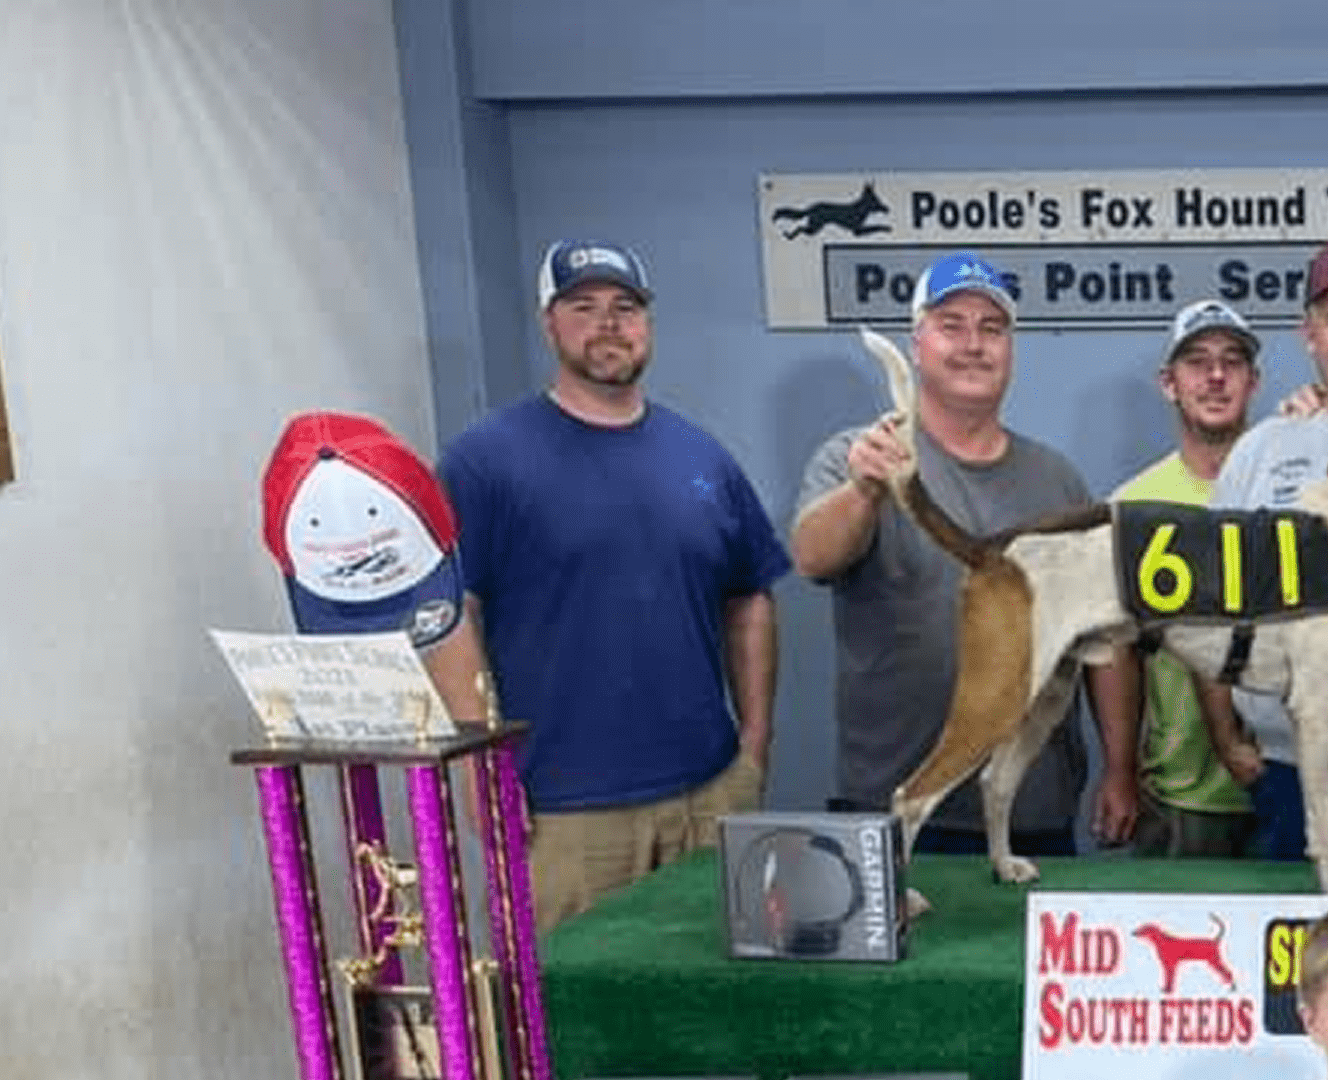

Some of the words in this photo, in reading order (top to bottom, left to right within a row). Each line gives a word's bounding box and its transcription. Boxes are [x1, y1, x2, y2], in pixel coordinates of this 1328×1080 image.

[911, 189, 1061, 230] Poole's
[1081, 189, 1154, 230] Fox
[1177, 187, 1304, 229] Hound
[1045, 261, 1173, 303] Point
[1218, 259, 1304, 302] Ser
[1138, 518, 1300, 613] 611
[859, 827, 888, 952] GARMIN
[1039, 980, 1149, 1050] SOUTH
[1160, 996, 1255, 1046] FEEDS
